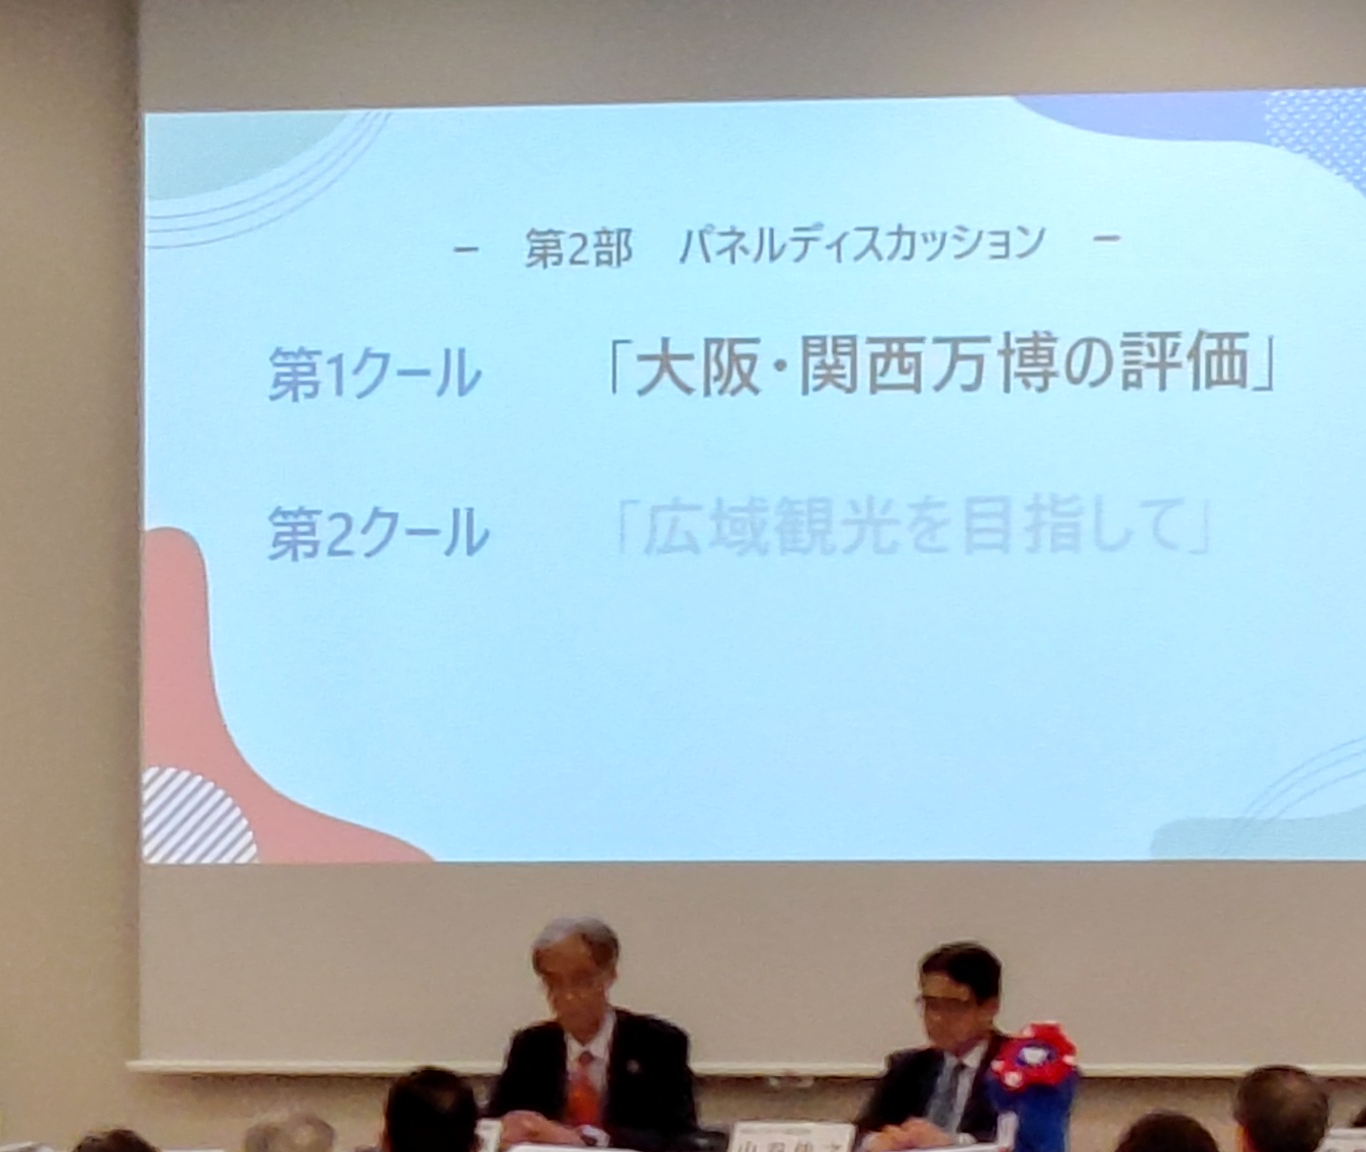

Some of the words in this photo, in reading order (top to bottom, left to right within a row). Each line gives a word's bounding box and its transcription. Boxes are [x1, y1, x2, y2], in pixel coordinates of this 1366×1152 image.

[523, 225, 635, 271] 第2部
[678, 219, 1048, 267] パネルディスカッション
[267, 344, 484, 404] 第1クール
[610, 326, 1276, 399] 「大阪・関西万博の評価」
[266, 503, 492, 564] 第2クール
[619, 491, 1212, 558] 「広域観光を目指して」
